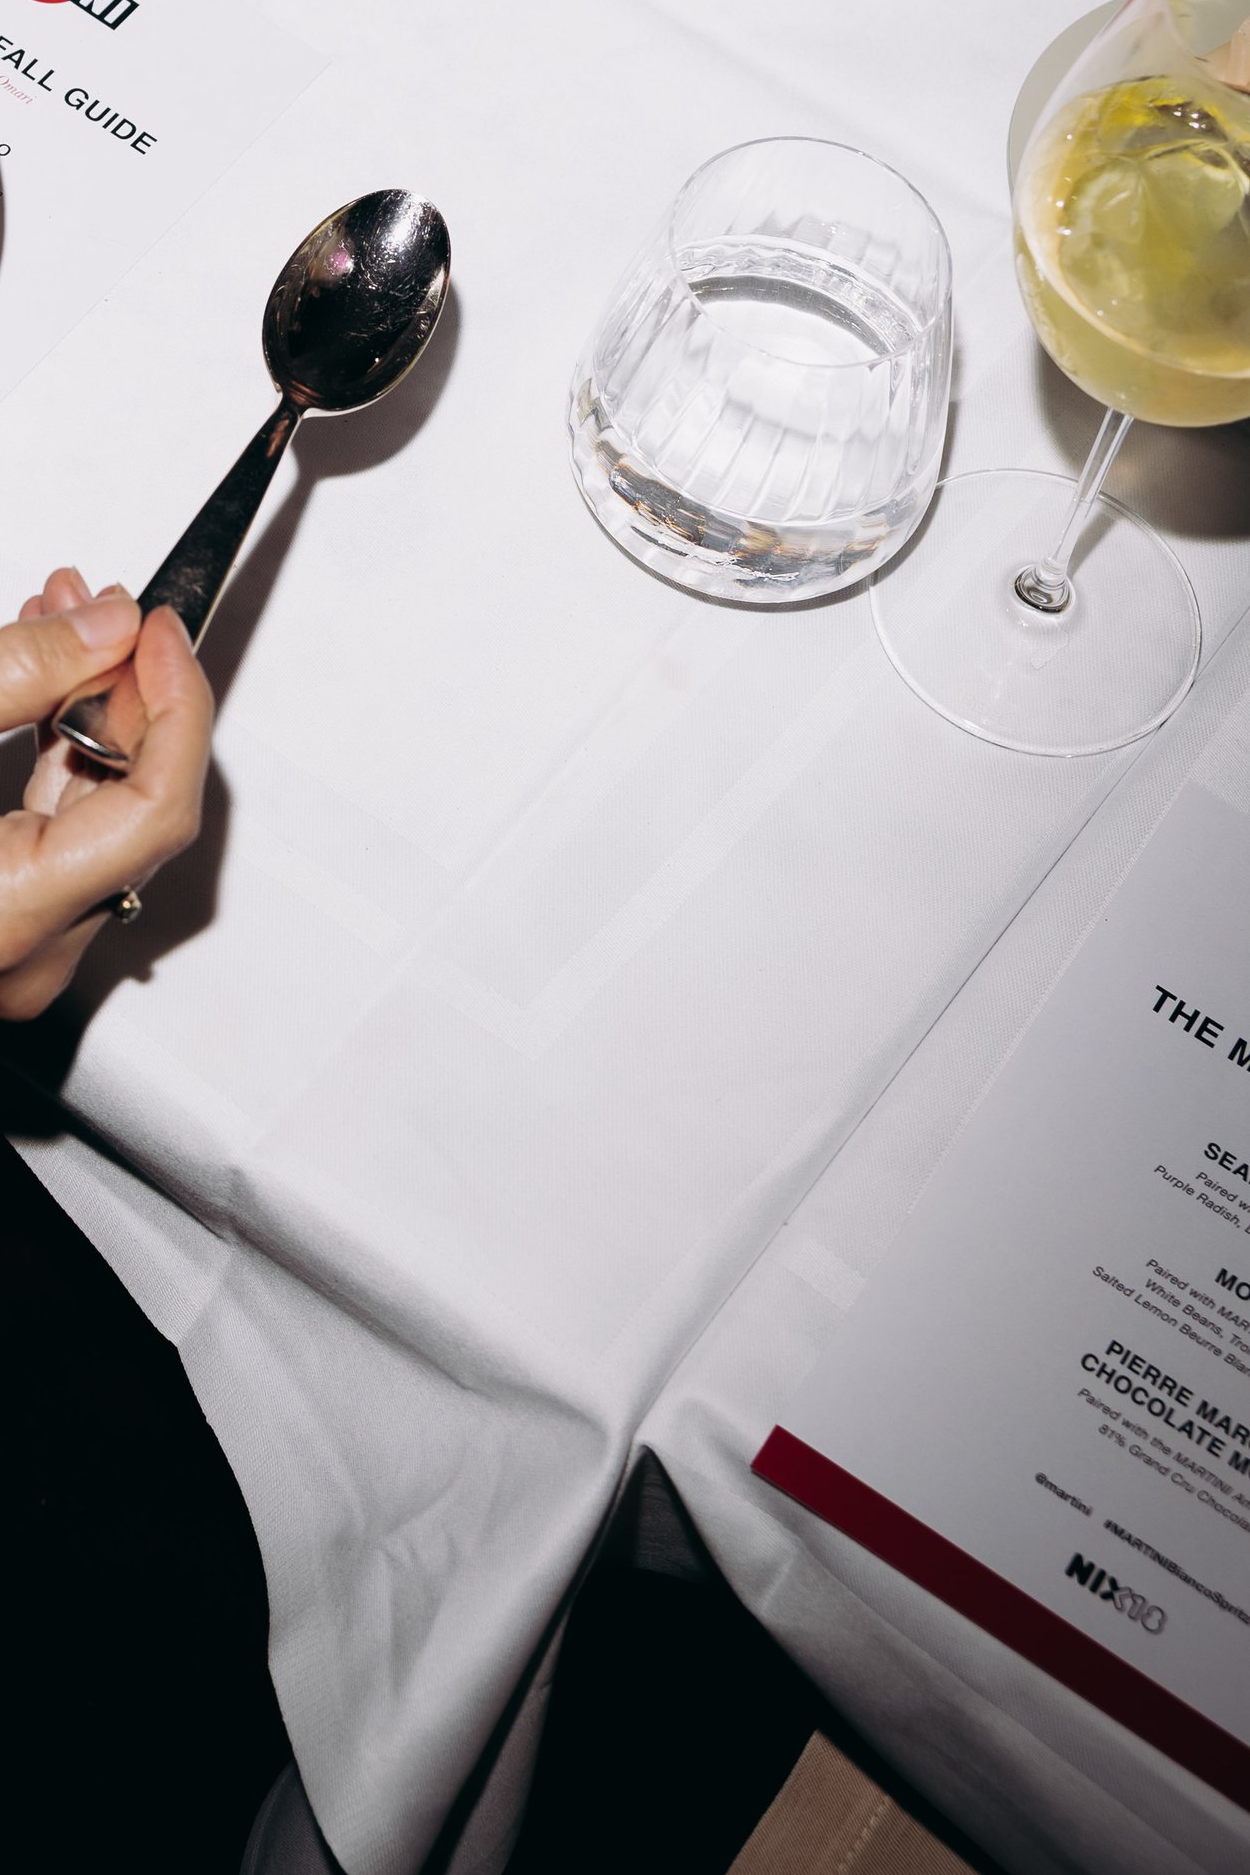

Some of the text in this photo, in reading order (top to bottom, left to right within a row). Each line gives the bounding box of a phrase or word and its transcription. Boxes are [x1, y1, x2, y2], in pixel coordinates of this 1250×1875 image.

[64, 87, 158, 156] GUIDE
[1152, 985, 1225, 1049] THE
[1153, 1164, 1195, 1196] Purple
[1195, 1171, 1239, 1203] Paired
[1203, 1142, 1250, 1185] SEA
[1092, 1265, 1135, 1298] Salted
[1134, 1293, 1179, 1328] Lemon
[1178, 1324, 1223, 1357] Beurre
[1145, 1278, 1182, 1308] White
[1145, 1258, 1250, 1335] Paired with MAR
[1077, 1387, 1122, 1421] Paired
[1121, 1418, 1150, 1441] with
[1150, 1437, 1172, 1456] the
[1080, 1352, 1226, 1459] CHOCOLATE
[1105, 1339, 1250, 1450] PIERRE MAR
[1034, 1471, 1094, 1517] @martini
[1128, 1444, 1171, 1477] Grand
[1170, 1471, 1196, 1495] Cru
